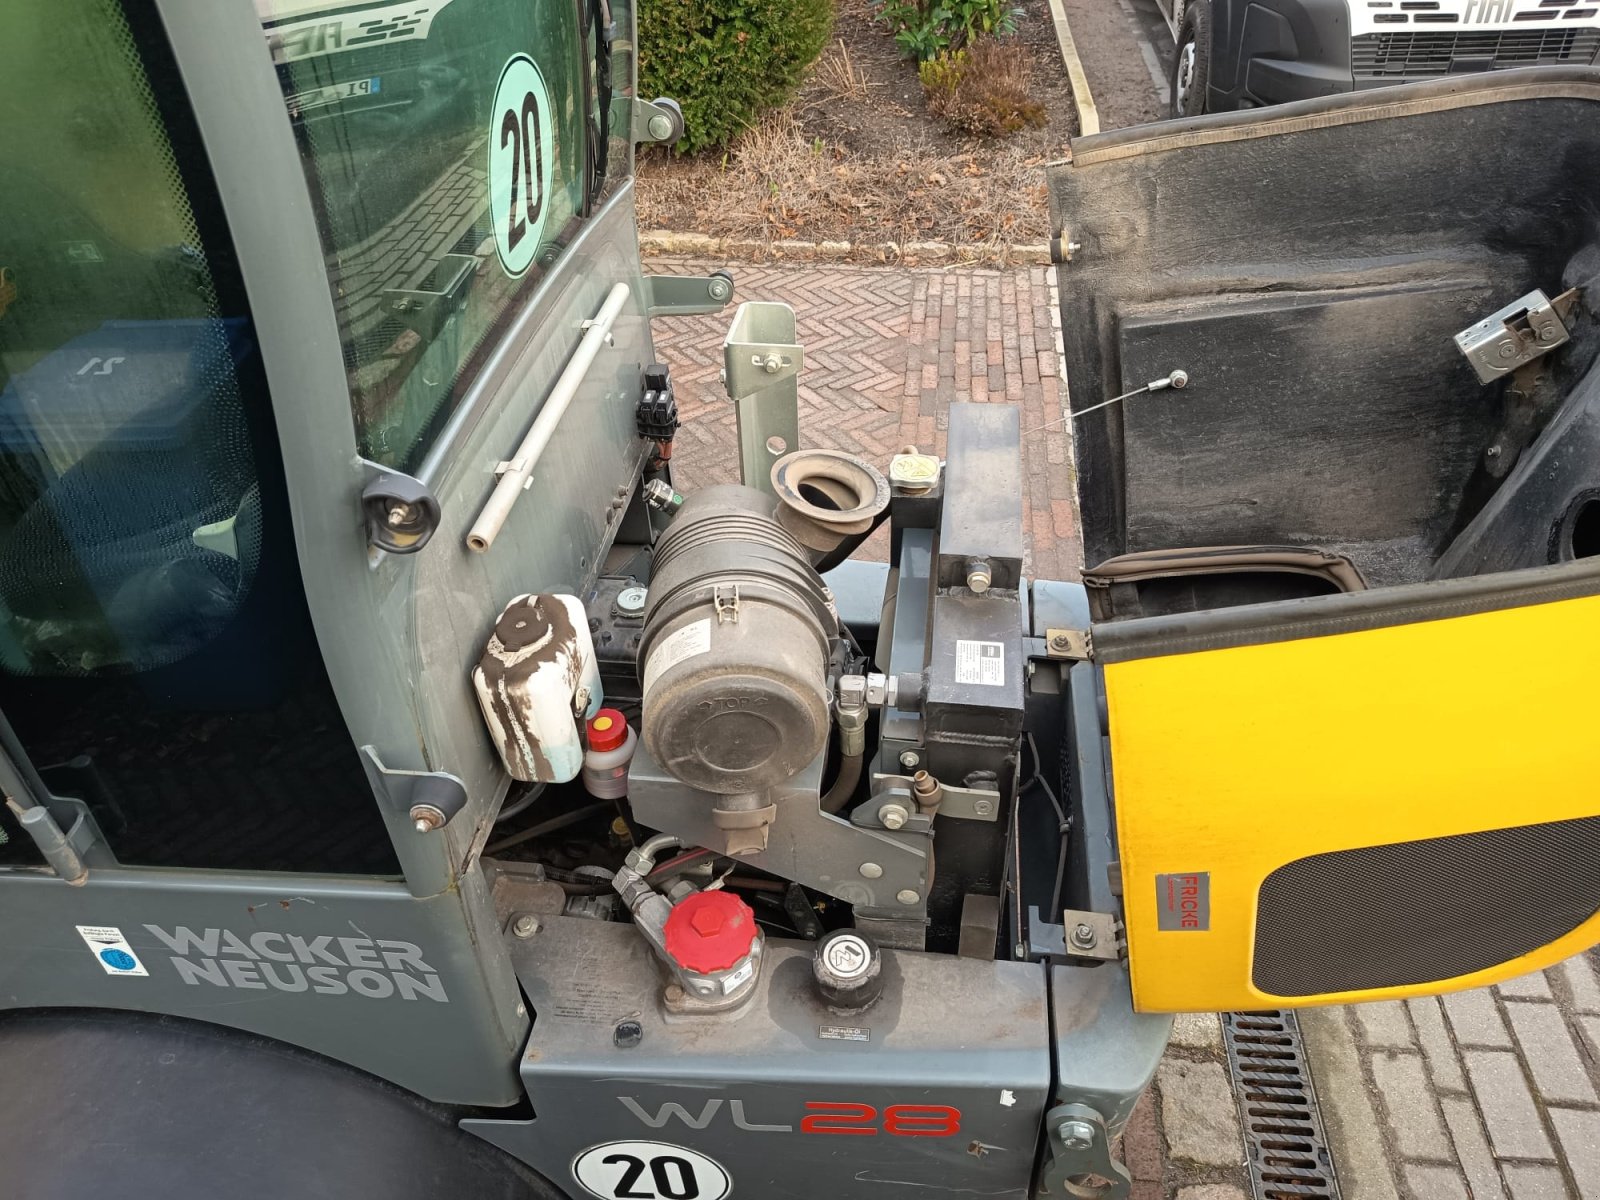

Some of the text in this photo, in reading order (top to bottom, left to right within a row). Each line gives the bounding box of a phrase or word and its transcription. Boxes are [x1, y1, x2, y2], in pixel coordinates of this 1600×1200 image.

[500, 91, 543, 254] 20
[1180, 876, 1198, 929] FRICKE
[142, 924, 438, 973] WACKER
[169, 956, 450, 1003] NEUSON
[601, 1153, 700, 1200] 20
